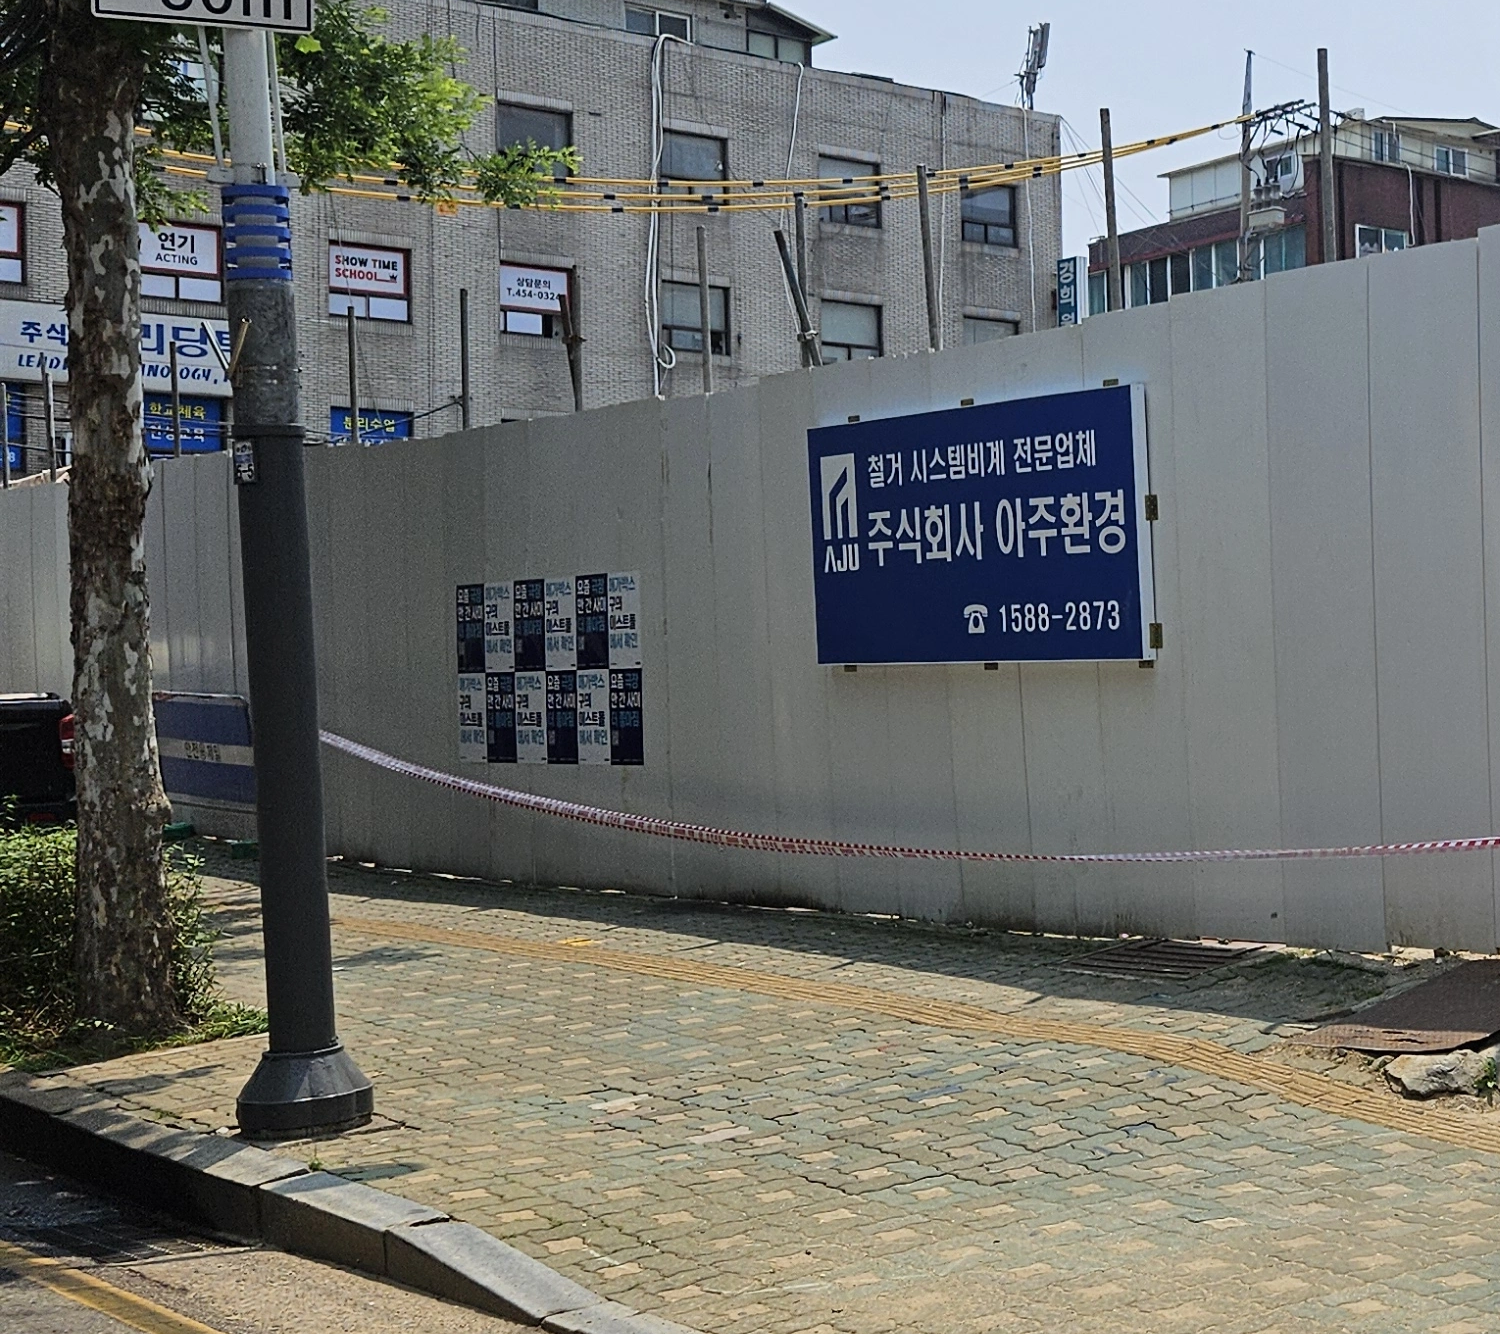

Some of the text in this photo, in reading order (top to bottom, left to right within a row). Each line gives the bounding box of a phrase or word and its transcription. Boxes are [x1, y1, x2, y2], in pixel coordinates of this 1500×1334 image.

[157, 232, 195, 254] 연기
[155, 253, 198, 266] ACTING
[335, 255, 398, 271] SHOW TIME
[335, 268, 384, 282] SCHOOL
[516, 277, 551, 290] 상담문의
[867, 429, 1097, 489] 철거 시스템비계 전문업체
[867, 489, 1127, 568] 주식회사 아주환경
[824, 543, 860, 574] AJU
[999, 600, 1121, 633] 1588-2873
